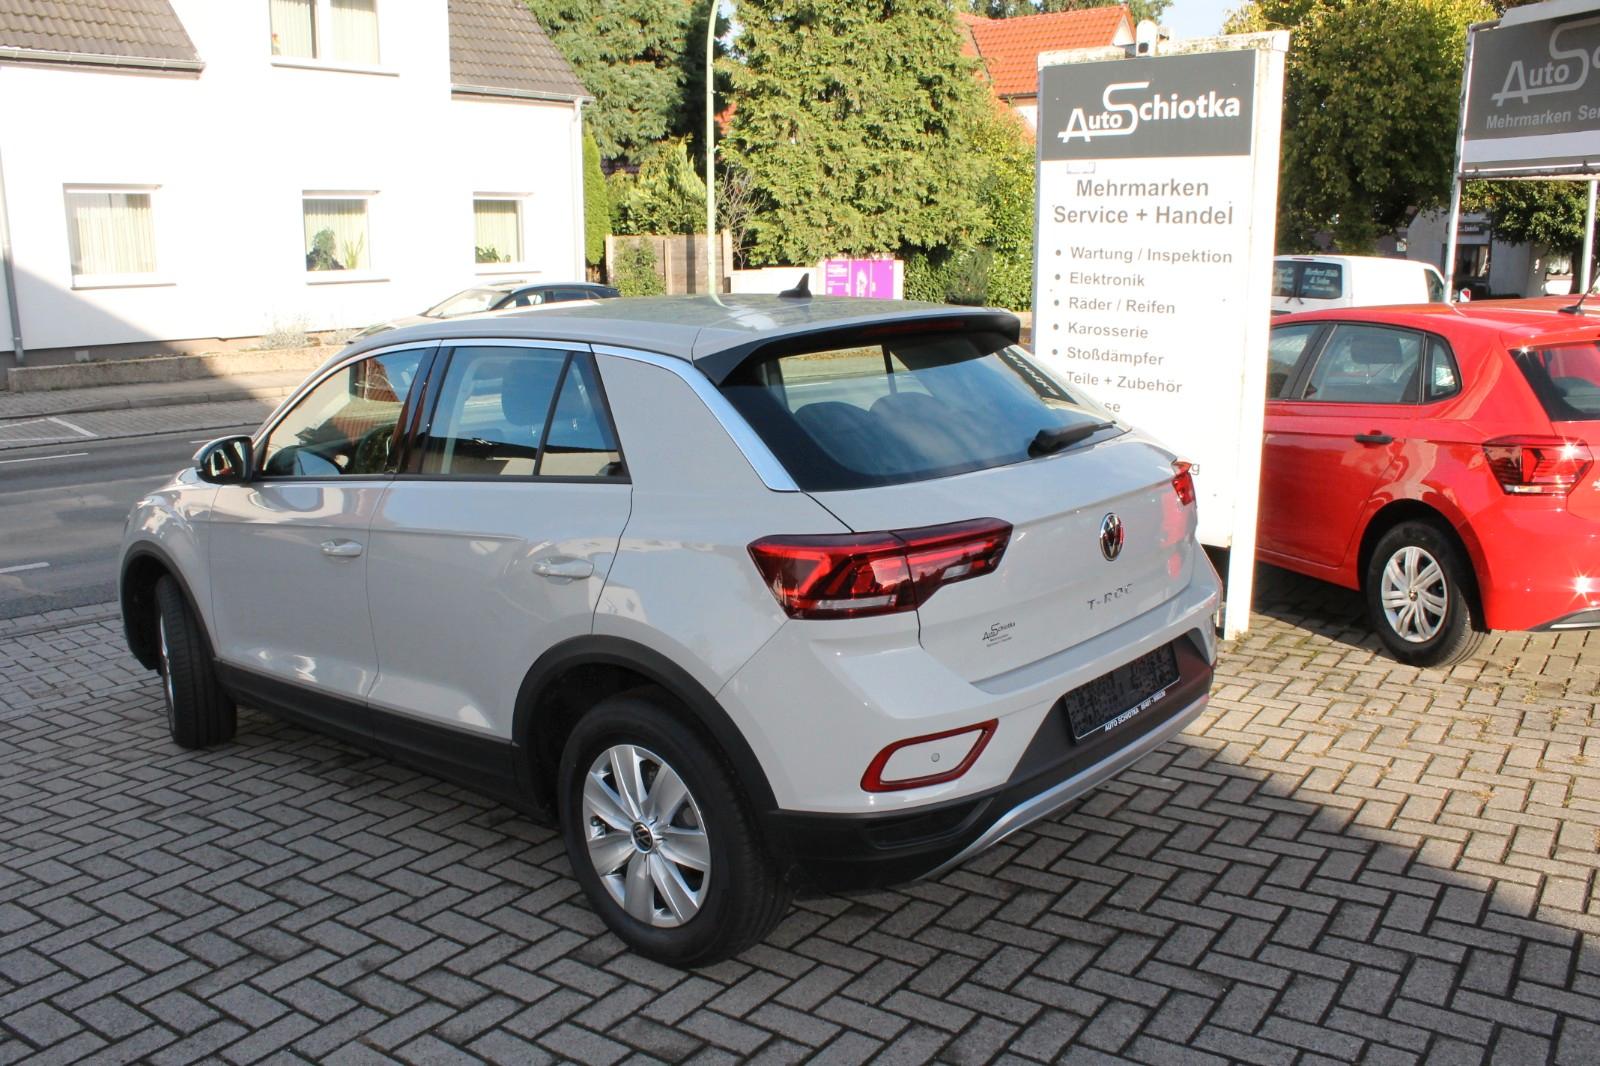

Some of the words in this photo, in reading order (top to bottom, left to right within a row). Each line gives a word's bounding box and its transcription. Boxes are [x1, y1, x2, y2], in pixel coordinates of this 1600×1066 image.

[1491, 60, 1570, 107] Auto
[1057, 107, 1123, 143] Auto
[1102, 81, 1240, 135] Schiotka
[1486, 109, 1571, 129] Mehrmarken
[1076, 178, 1209, 197] Mehrmarken
[1053, 205, 1128, 224] Service
[1136, 208, 1148, 221] +
[1156, 205, 1233, 225] Handel
[1070, 246, 1134, 263] Wartung
[1147, 248, 1232, 264] Inspektion
[1069, 272, 1145, 287] Elektronik
[1068, 297, 1113, 311] Räder
[1126, 299, 1176, 314] Reifen
[1067, 322, 1149, 339] Karosserie
[1067, 346, 1164, 367] Stoßdämpfer
[1066, 371, 1099, 386] Teile
[1117, 375, 1182, 393] Zubehör
